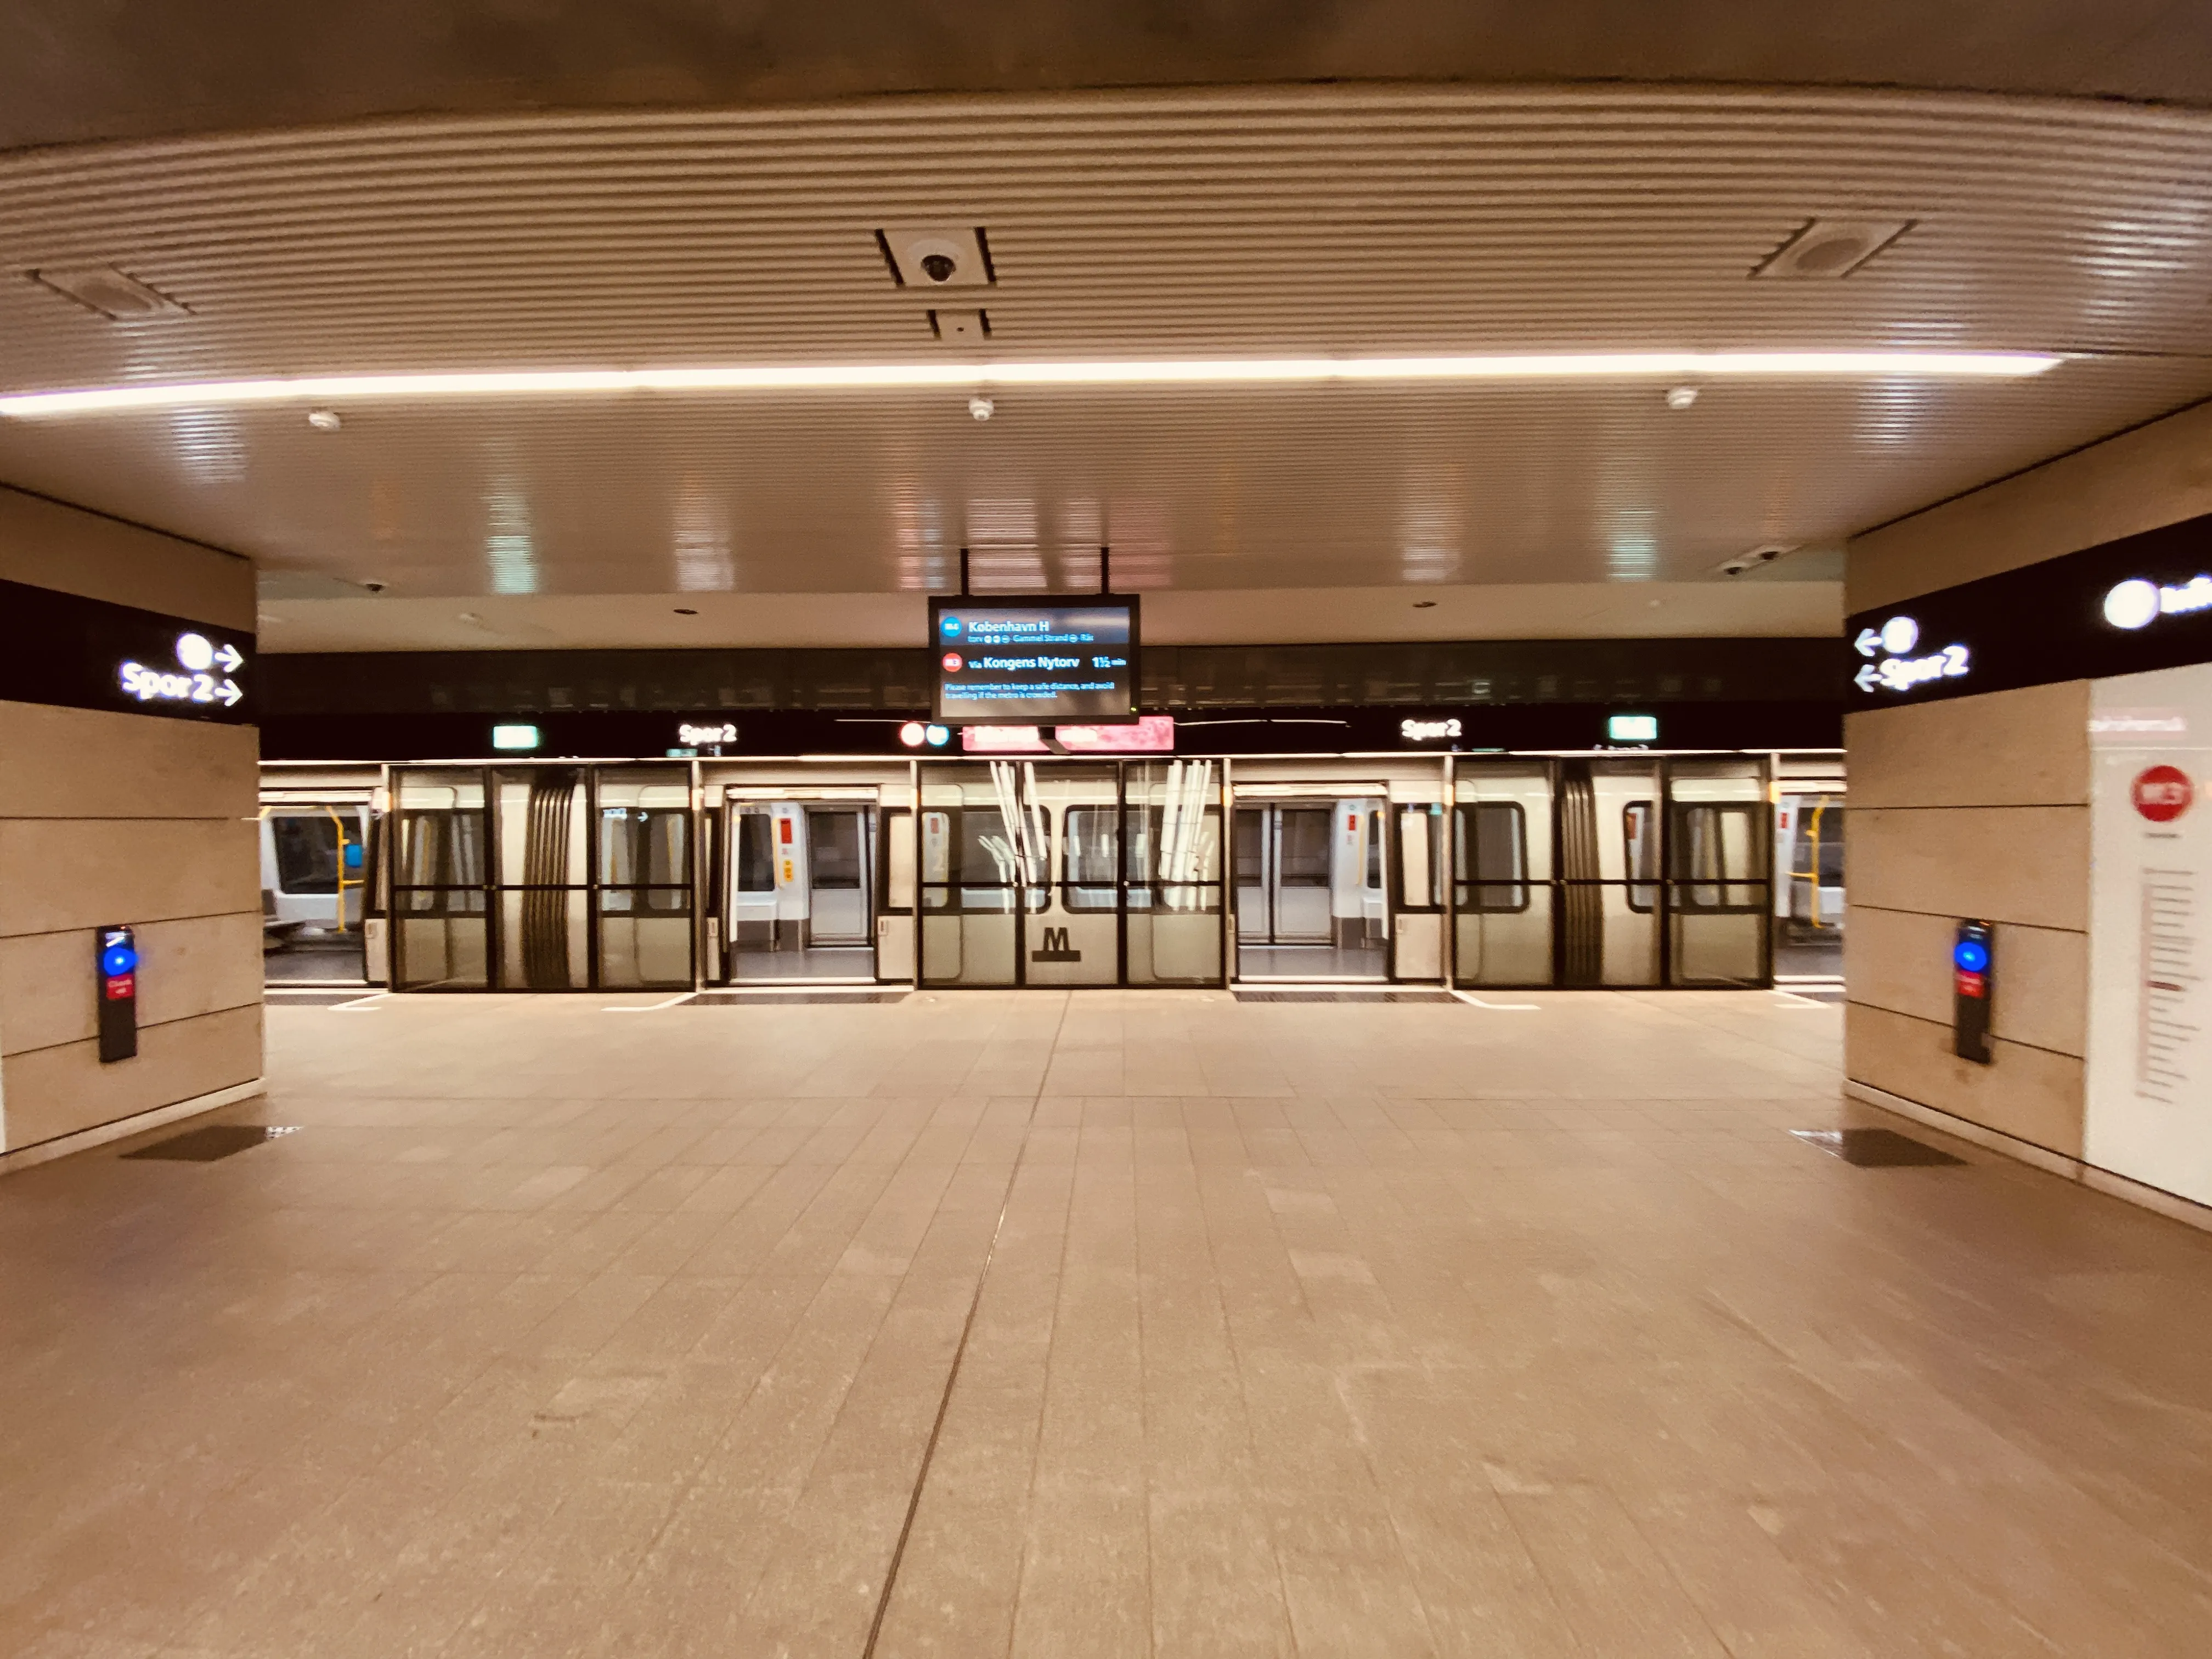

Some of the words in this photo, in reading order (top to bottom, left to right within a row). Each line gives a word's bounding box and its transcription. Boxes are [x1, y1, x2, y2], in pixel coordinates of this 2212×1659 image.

[1039, 621, 1049, 631] H
[983, 657, 1036, 670] Kongens
[1037, 657, 1080, 670] Nytorv
[1880, 655, 1946, 690] Spor
[1942, 644, 1970, 676] 2
[121, 662, 193, 700] Spor
[192, 674, 214, 702] 2
[679, 724, 723, 746] Spor
[723, 724, 737, 741] 2
[1401, 719, 1448, 741] Spor
[1447, 719, 1462, 736] 2
[1043, 927, 1070, 951] M
